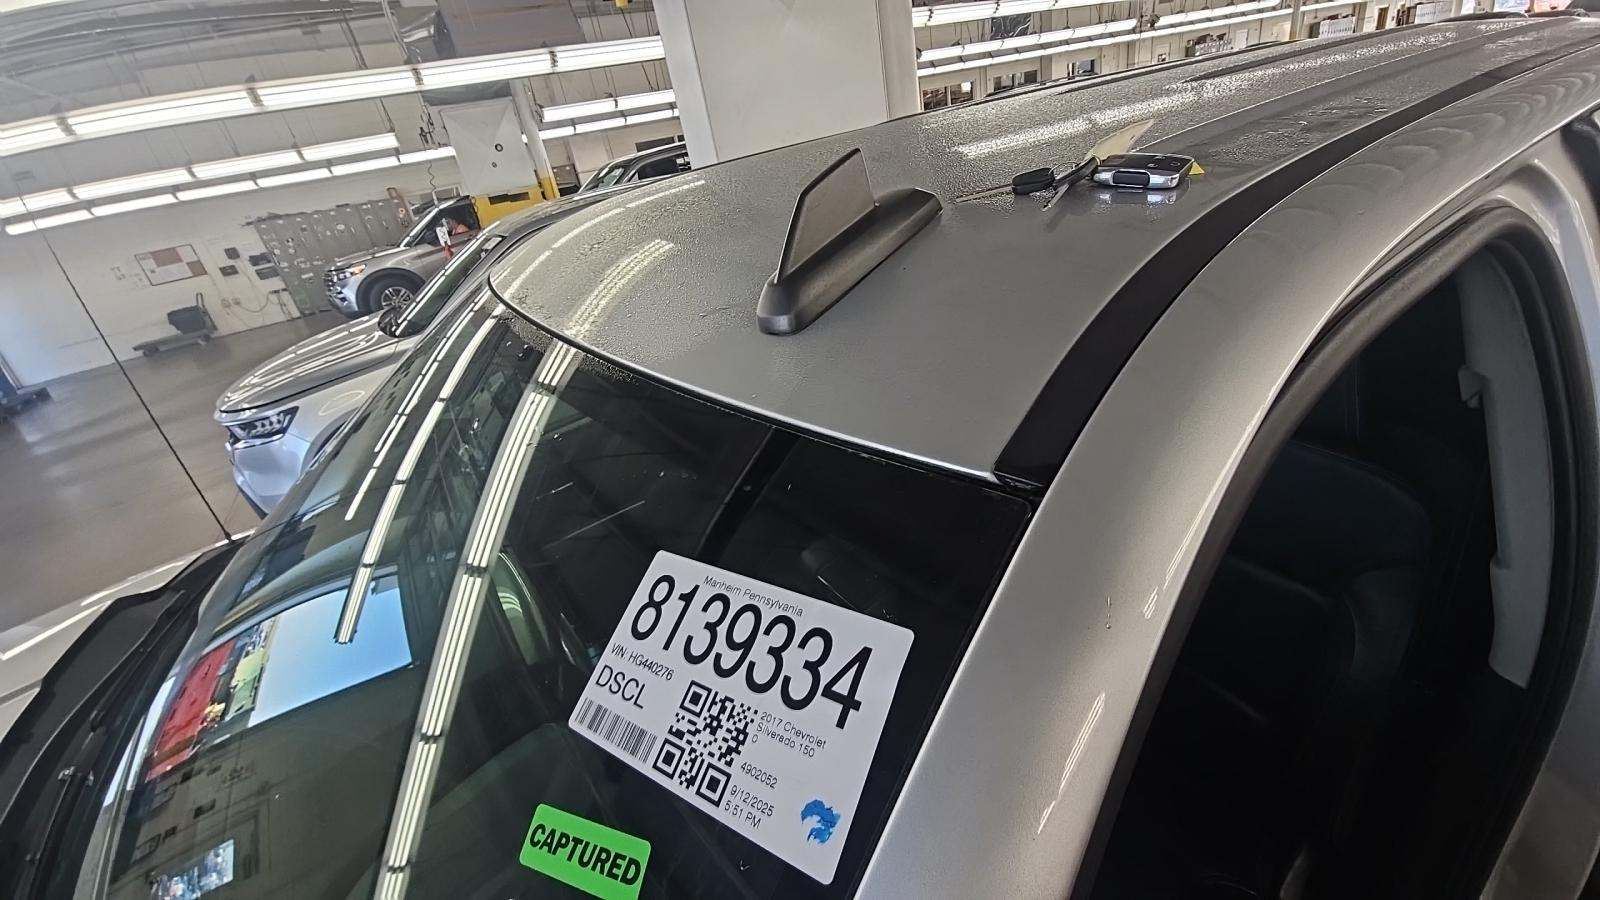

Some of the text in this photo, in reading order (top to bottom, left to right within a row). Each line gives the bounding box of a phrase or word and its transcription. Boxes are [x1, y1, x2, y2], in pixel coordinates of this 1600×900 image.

[703, 575, 804, 617] Manheim Pennsylvania
[628, 651, 675, 682] HG440276
[631, 574, 873, 730] 8139334
[595, 665, 648, 709] DSCL
[756, 722, 816, 758] Silverado 150
[760, 711, 827, 750] 2017 Chevrolet
[740, 761, 778, 790] 4902052
[724, 800, 761, 829] 5:51 PM
[729, 785, 775, 817] 9/12/2025
[528, 822, 643, 887] CAPTURED
